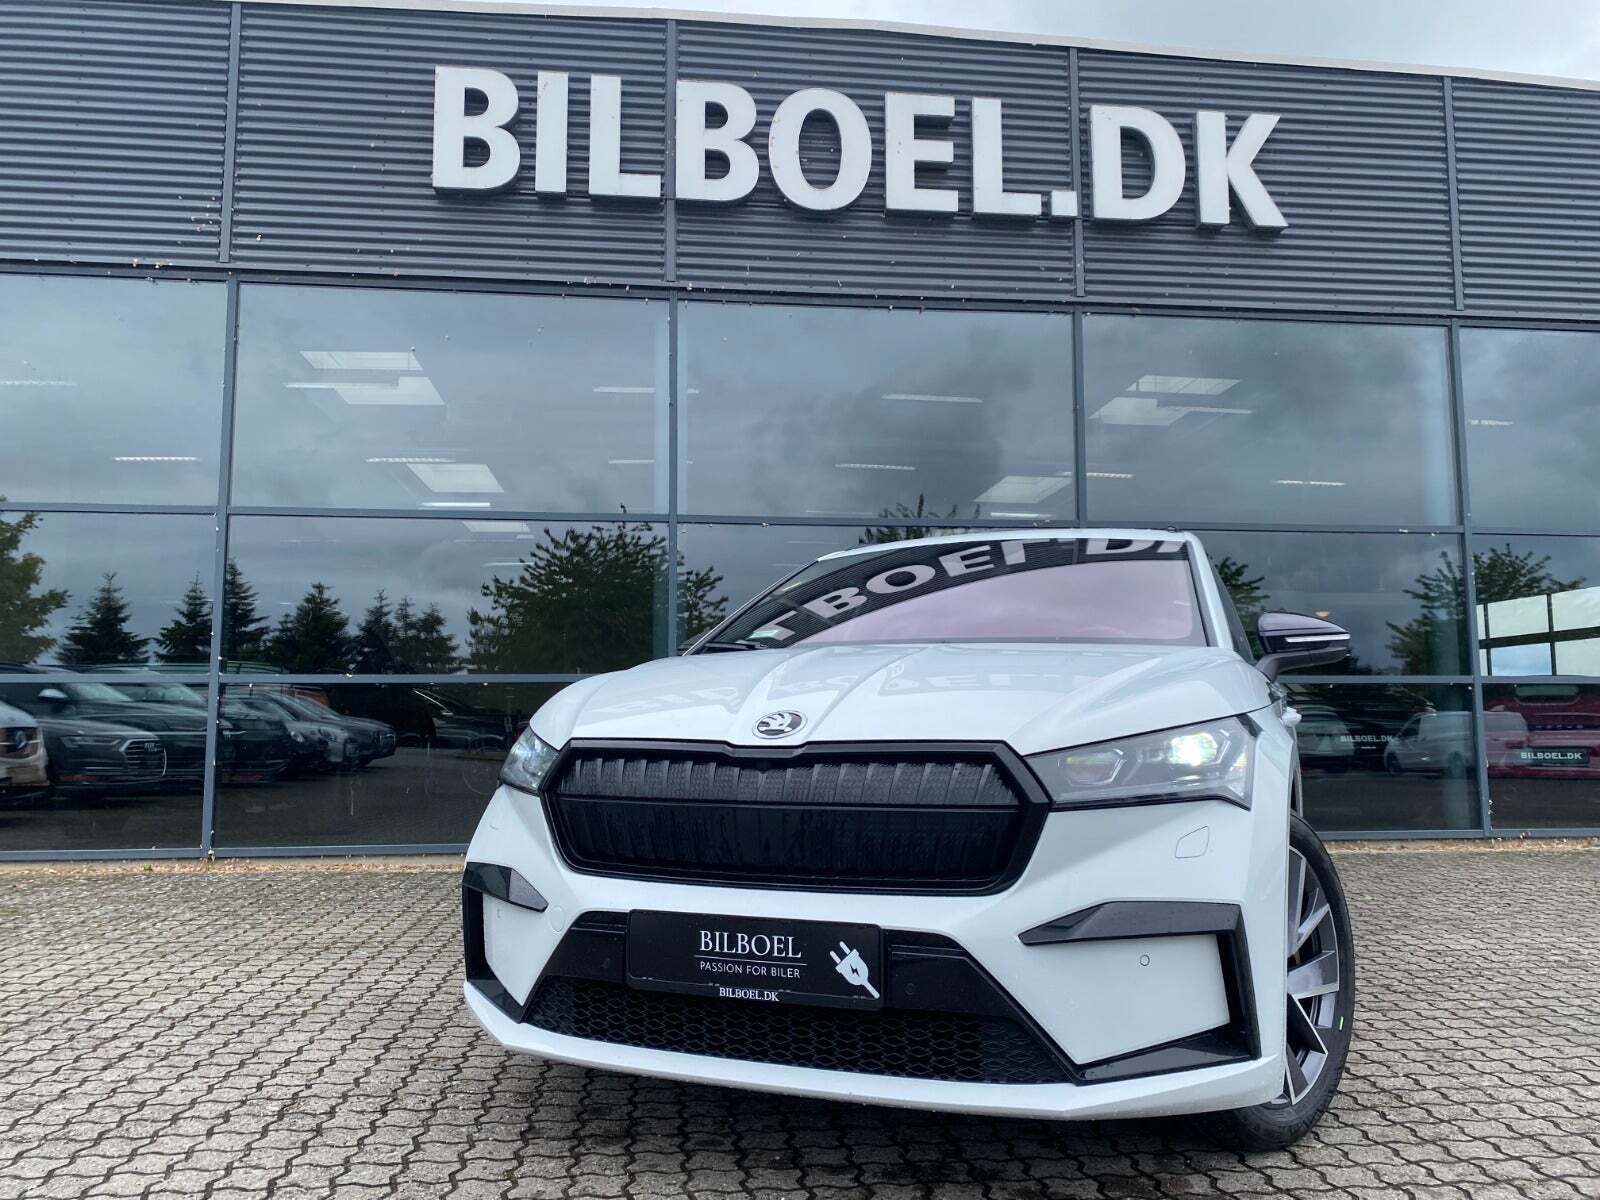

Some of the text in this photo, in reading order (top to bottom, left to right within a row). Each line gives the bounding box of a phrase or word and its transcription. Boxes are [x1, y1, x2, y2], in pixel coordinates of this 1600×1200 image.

[432, 65, 1289, 232] BILBOEL.DK
[1520, 752, 1583, 760] BILBOEL.DK
[699, 930, 802, 958] BILBOEL
[700, 960, 801, 979] PASSION FOR BILER
[719, 987, 780, 1002] BILBOEL.DK
